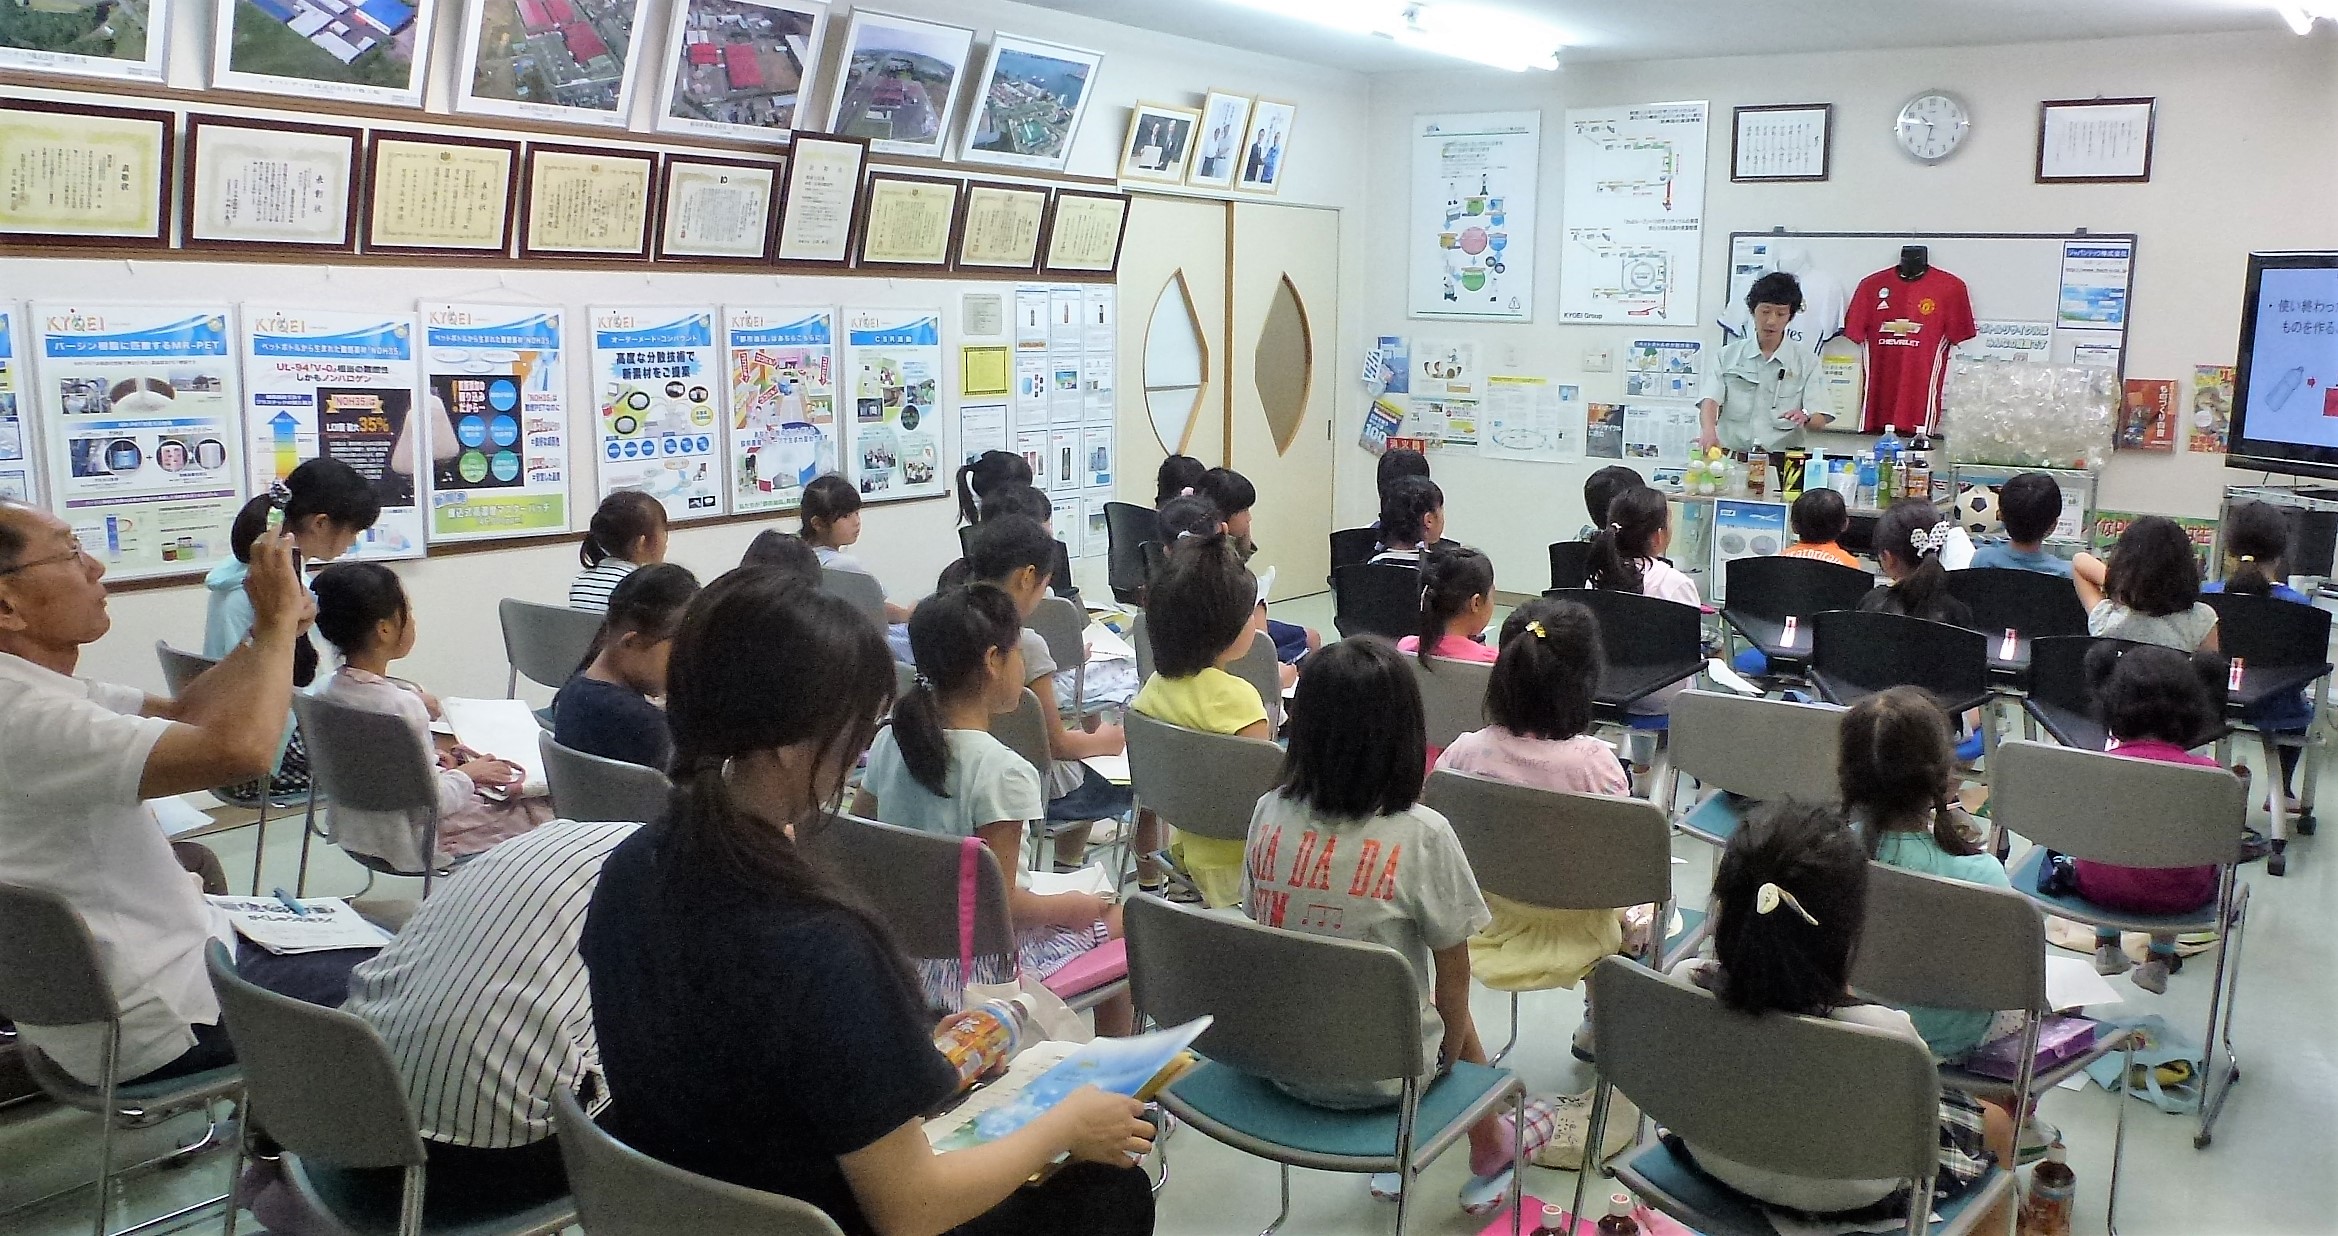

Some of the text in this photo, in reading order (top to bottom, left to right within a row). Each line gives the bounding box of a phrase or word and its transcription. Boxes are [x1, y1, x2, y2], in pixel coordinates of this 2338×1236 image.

[47, 315, 105, 331] KYOEI
[255, 318, 305, 333] KYOEI
[429, 313, 471, 325] KYOEI
[597, 316, 635, 328] KYOEI
[616, 351, 695, 365] 高度な分散技術で
[622, 366, 691, 380] 新素材をご提案
[1365, 423, 1388, 444] 100
[1288, 831, 1337, 890] DA
[1348, 838, 1401, 900] DA
